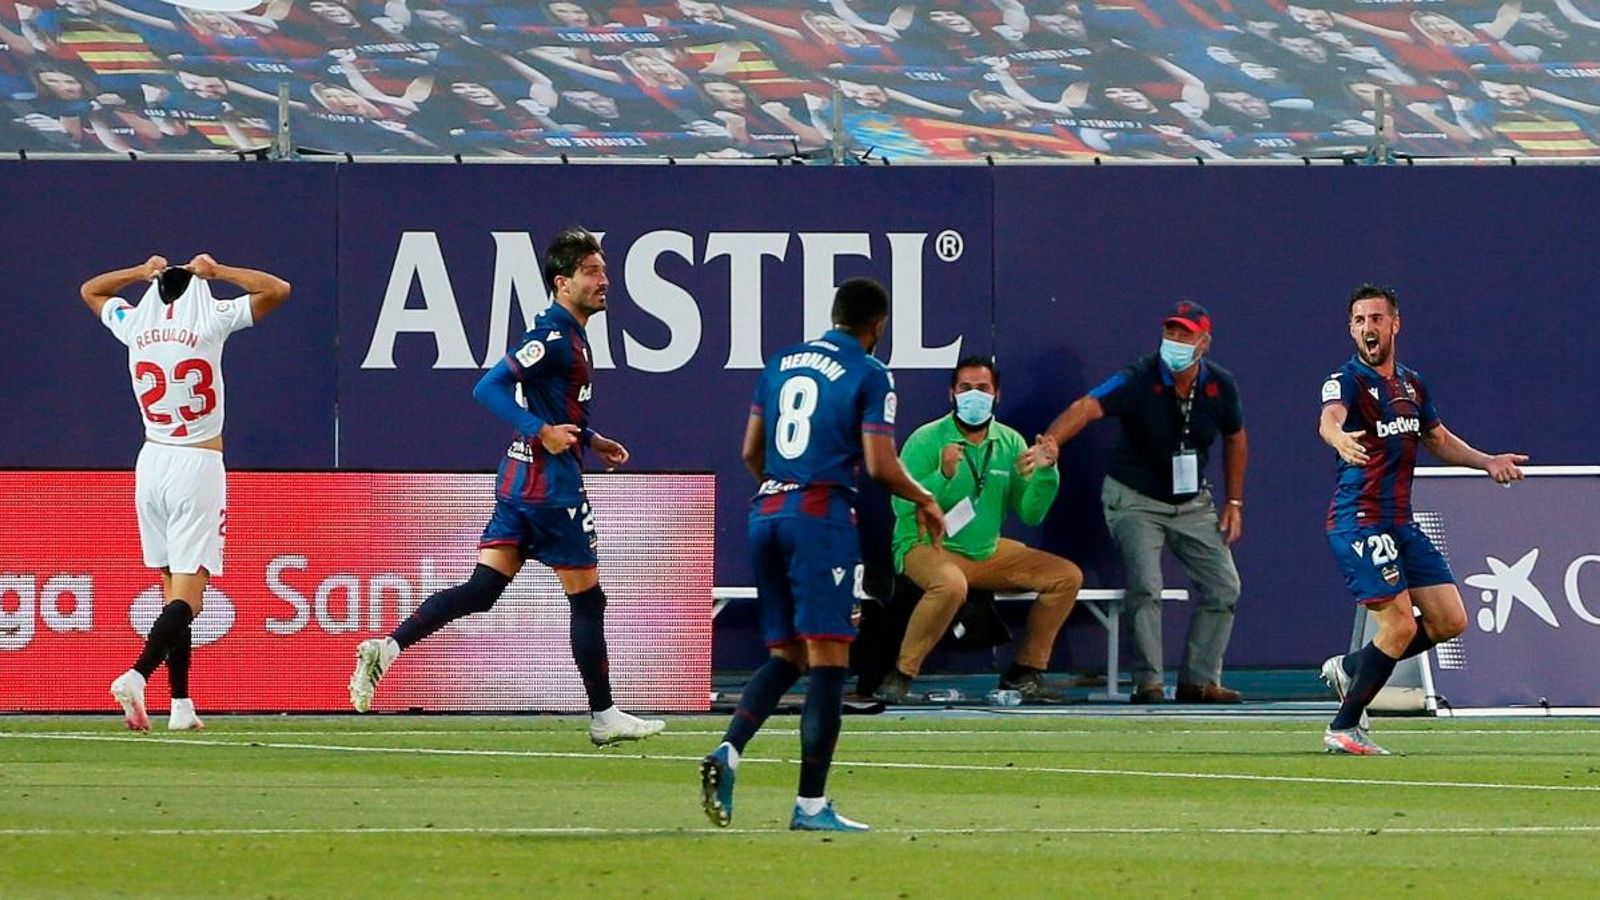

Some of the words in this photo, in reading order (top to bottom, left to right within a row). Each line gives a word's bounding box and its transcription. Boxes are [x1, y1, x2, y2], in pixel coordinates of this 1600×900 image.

[557, 32, 633, 43] LEVANTE
[634, 33, 660, 42] UD
[779, 351, 847, 382] HERNANI
[135, 358, 216, 426] 23
[775, 375, 819, 460] 8
[1367, 533, 1399, 567] 20
